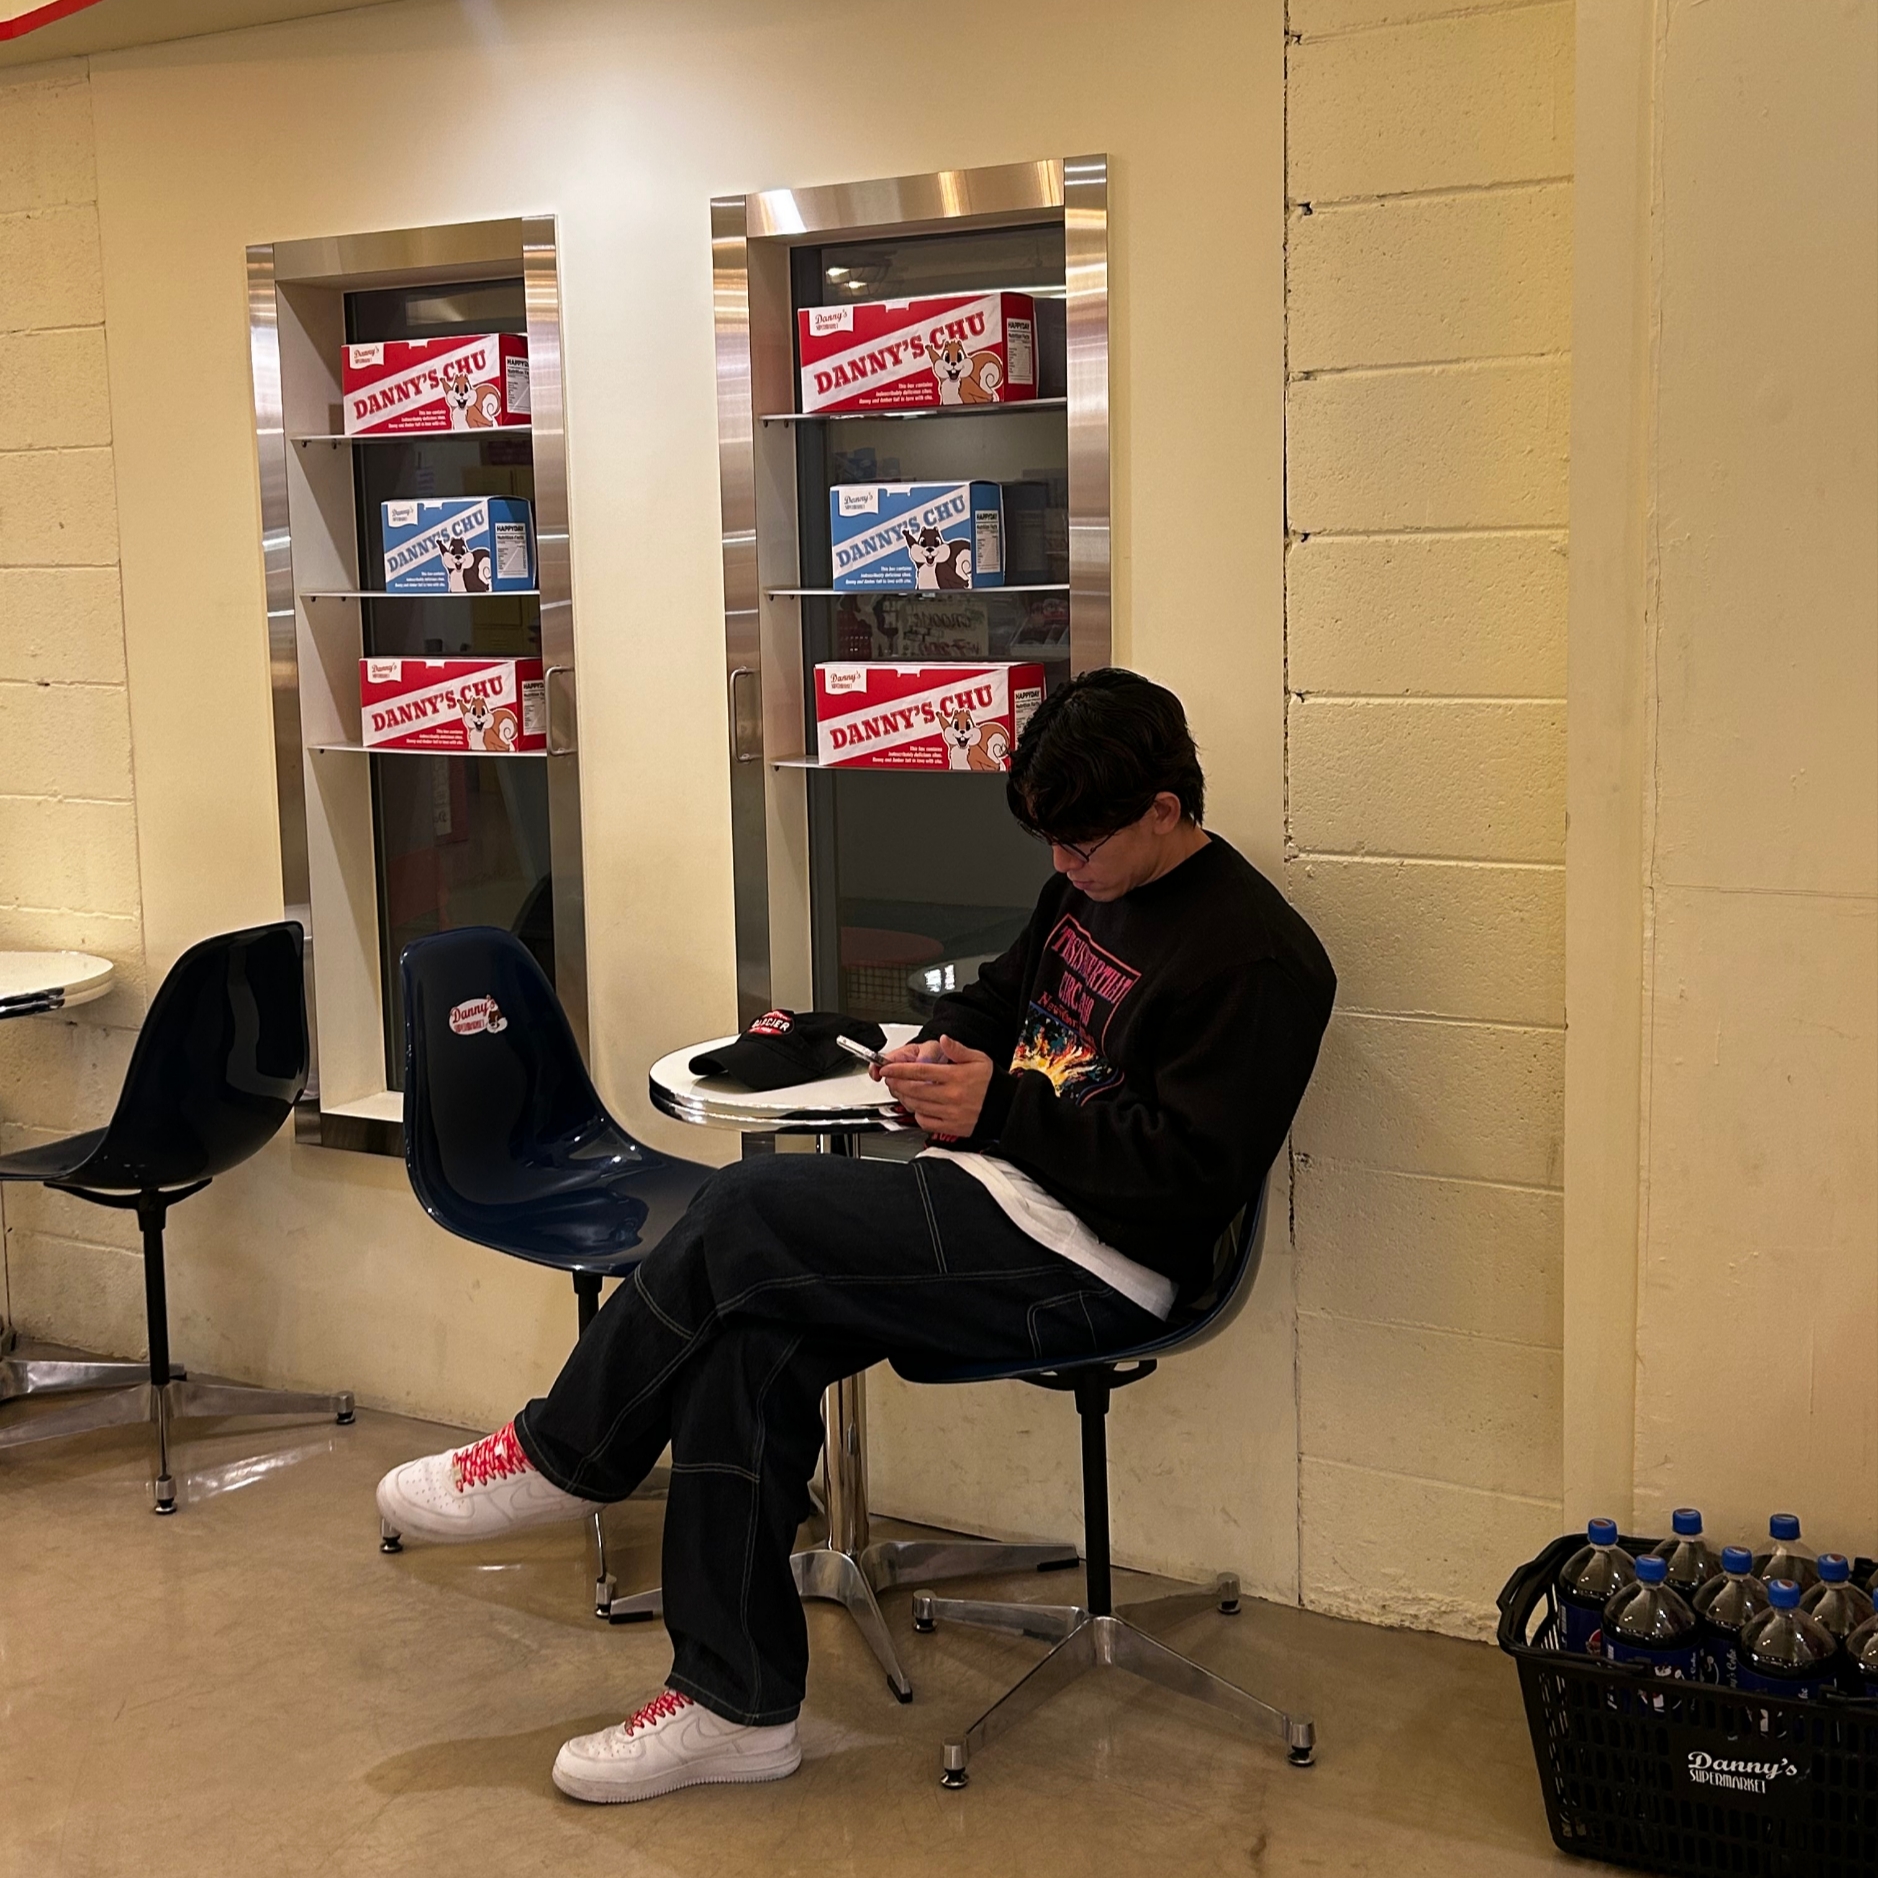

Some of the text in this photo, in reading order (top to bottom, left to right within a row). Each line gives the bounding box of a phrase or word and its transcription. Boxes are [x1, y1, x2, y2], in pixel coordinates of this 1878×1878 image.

[815, 309, 847, 325] Danny's
[814, 311, 986, 396] DANNY'S CHU
[353, 349, 487, 420] DANNY'S CHU
[387, 509, 485, 572] DANNY'S CHU
[836, 495, 966, 567] DANNY'S CHU
[372, 675, 503, 732] DANNY'S CHU
[830, 670, 861, 683] Danny's
[830, 684, 993, 750] DANNY'S CHU
[450, 1000, 495, 1023] Danny's
[1688, 1751, 1798, 1780] Danny's
[1689, 1768, 1766, 1794] SUPERMARKET
